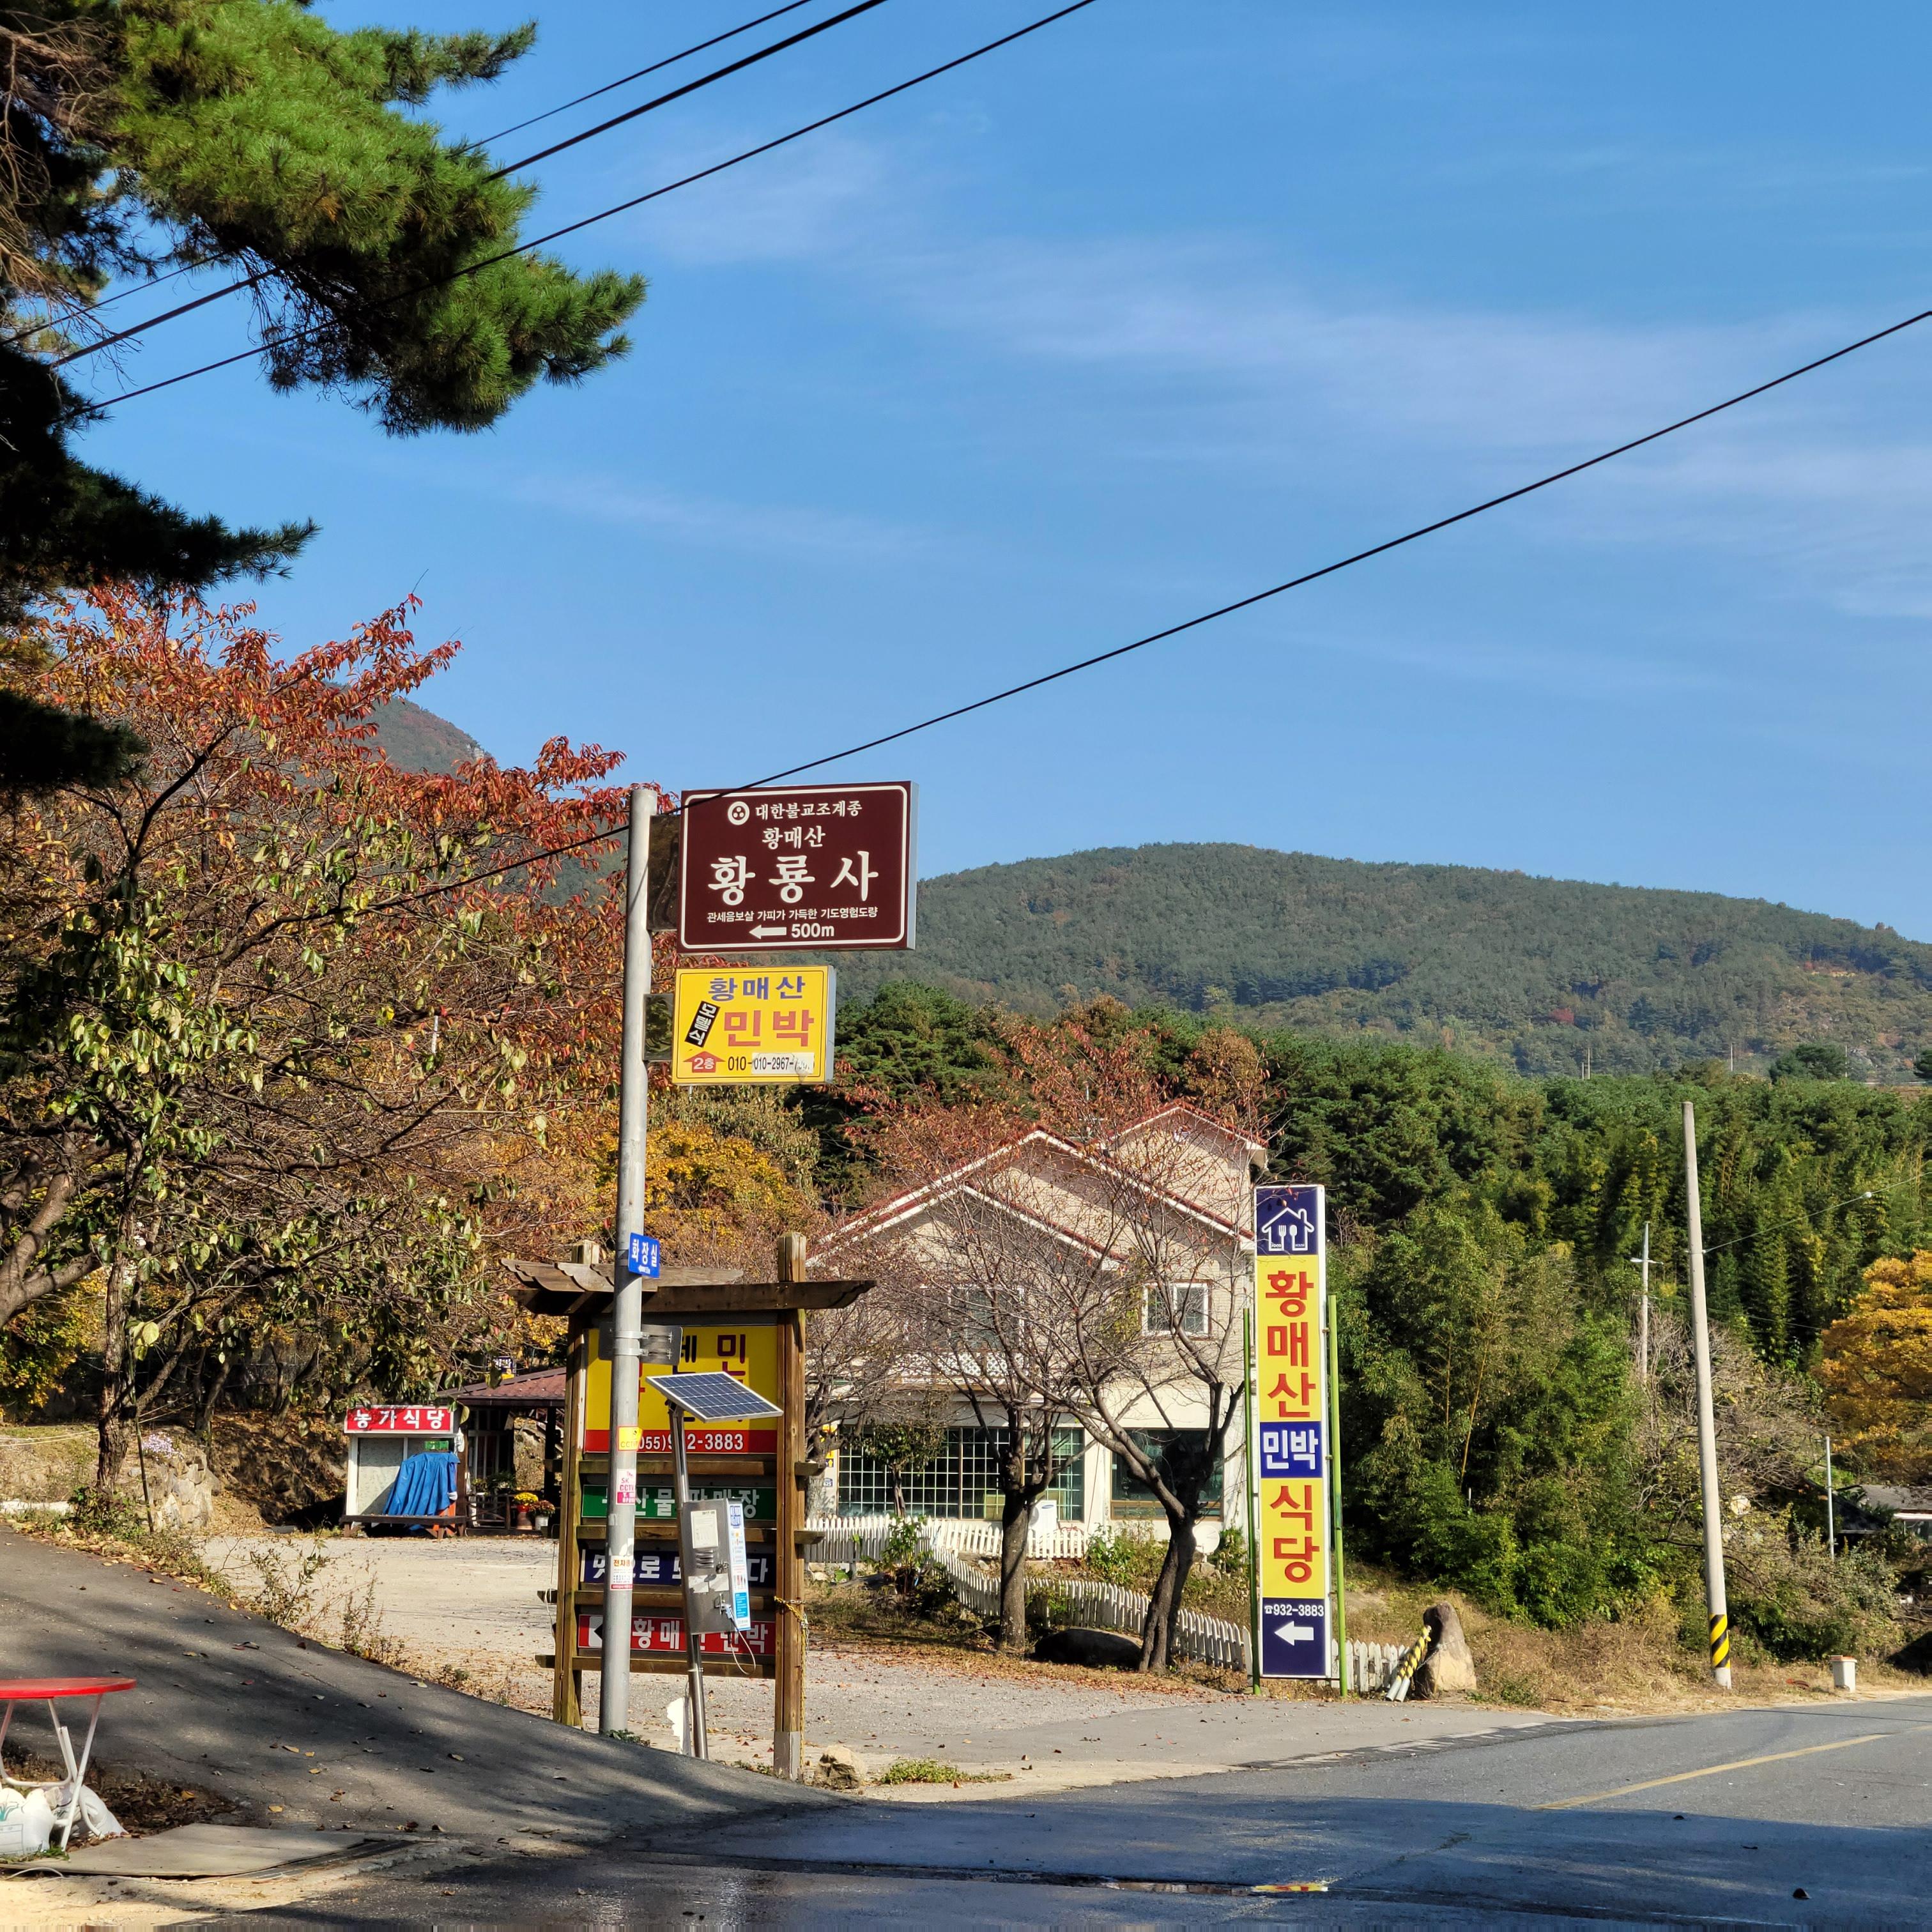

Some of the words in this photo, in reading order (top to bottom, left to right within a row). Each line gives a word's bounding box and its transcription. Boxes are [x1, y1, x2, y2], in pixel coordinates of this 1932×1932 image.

[755, 800, 862, 820] 대한불교조계종
[762, 825, 826, 850] 황매산
[708, 850, 878, 905] 황룡사
[707, 910, 755, 923] 관세음보살
[757, 909, 786, 921] 가피가
[789, 908, 818, 920] 가득한
[820, 906, 878, 920] 기도영험도량
[791, 923, 835, 938] 500m
[708, 976, 806, 1002] 황매산
[689, 1002, 717, 1046] 모텔식
[724, 1009, 815, 1047] 민박
[693, 1057, 715, 1070] 2층
[632, 1238, 657, 1268] 화장실
[1265, 1269, 1317, 1418] 황매산
[353, 1408, 445, 1430] 농가식당
[1262, 1429, 1319, 1470] 민박
[1269, 1485, 1320, 1584] 식당
[1273, 1604, 1324, 1618] 932-3883
